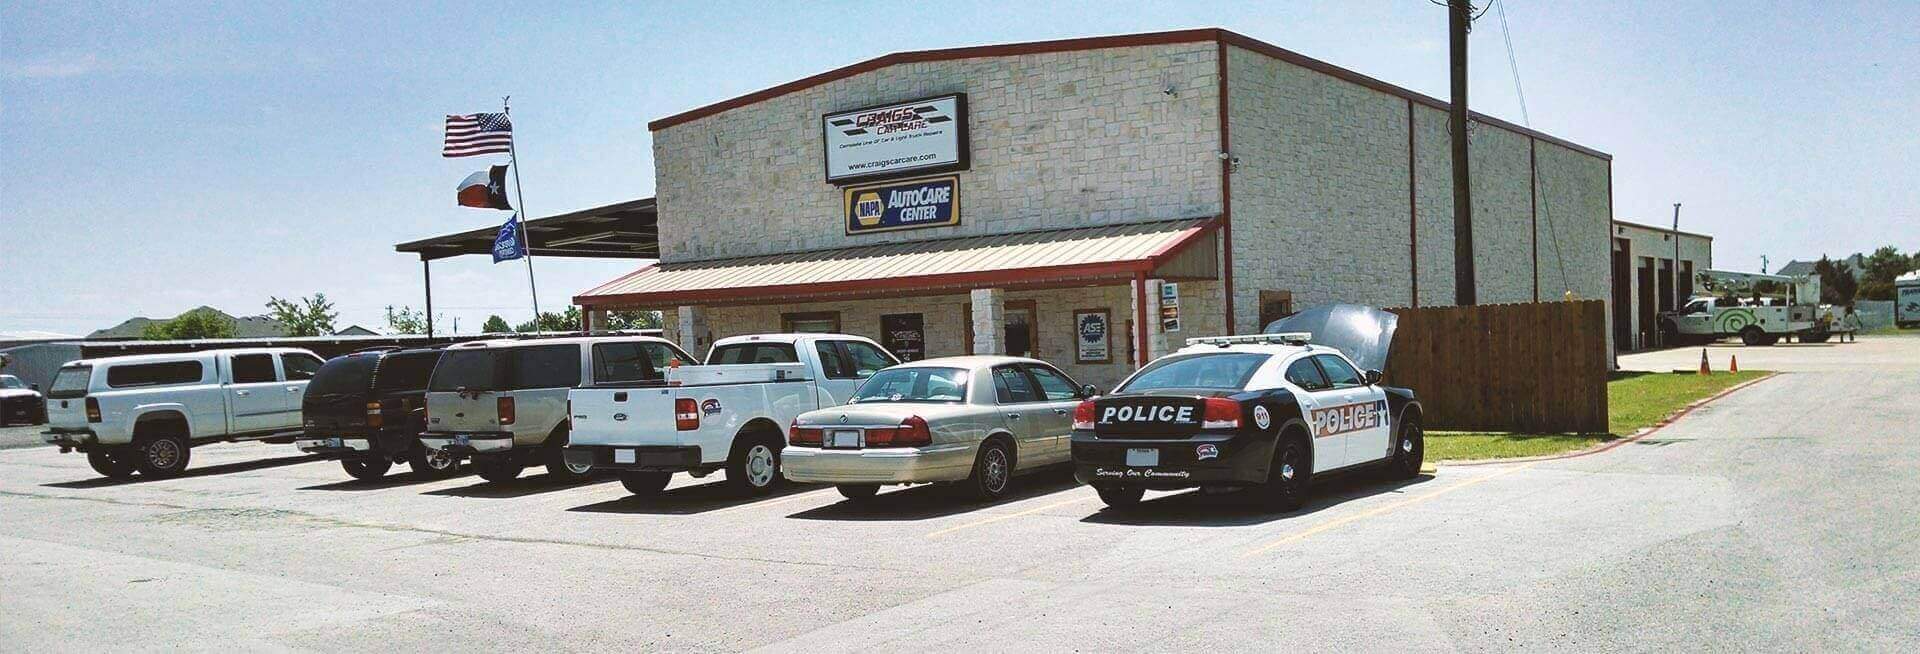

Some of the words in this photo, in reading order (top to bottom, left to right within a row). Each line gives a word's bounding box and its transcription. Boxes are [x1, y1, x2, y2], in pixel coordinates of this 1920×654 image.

[856, 107, 914, 127] CRAIGS
[848, 152, 937, 170] www.craigscarcare.com
[860, 200, 881, 217] NAPA
[900, 205, 937, 222] CENTER
[1083, 322, 1101, 333] ASE
[1102, 405, 1194, 422] POLICE
[1255, 411, 1268, 421] 911
[1315, 403, 1376, 437] POLICE
[1096, 468, 1123, 478] Serving
[1126, 469, 1141, 477] Our
[1144, 468, 1190, 478] Community
